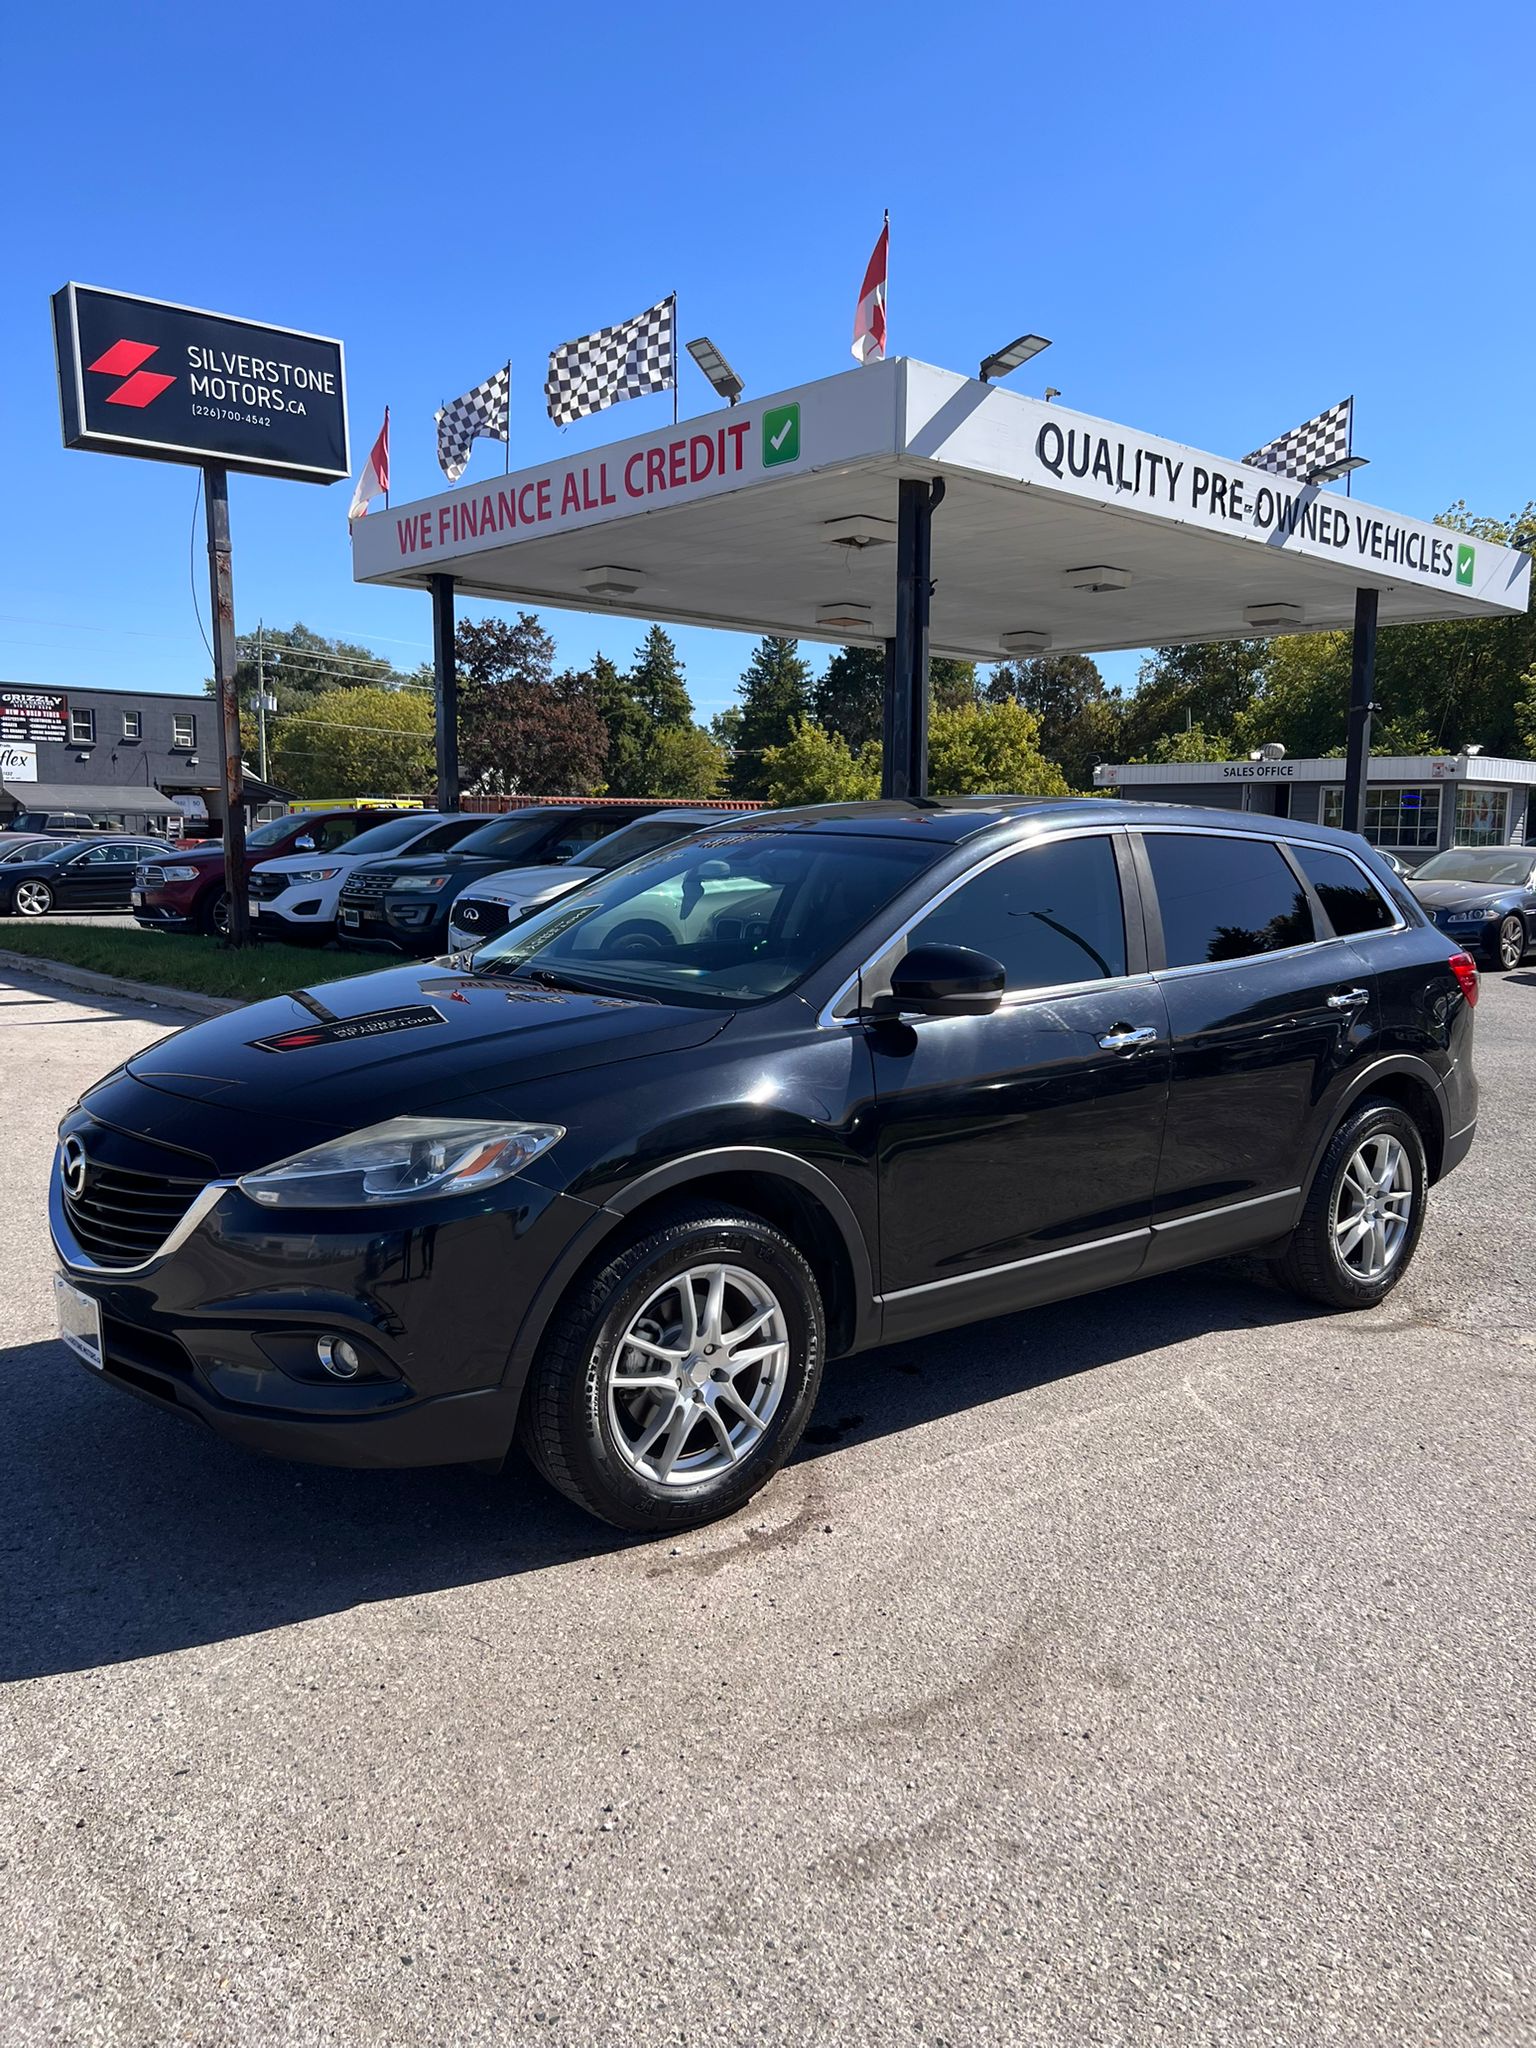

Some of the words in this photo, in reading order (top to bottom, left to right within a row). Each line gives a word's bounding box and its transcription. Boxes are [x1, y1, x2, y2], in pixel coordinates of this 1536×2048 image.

[187, 345, 335, 395] SILVERSTONE
[190, 373, 307, 416] MOTORS.CA
[192, 403, 271, 427] (226)700-4542
[397, 511, 433, 555] WE
[438, 478, 552, 546] FINANCE
[560, 462, 617, 516] ALL
[624, 420, 751, 499] CREDIT
[1038, 421, 1184, 502] QUALITY
[1191, 466, 1350, 549] PRE-OWNED
[1356, 515, 1454, 577] VEHICLES
[1, 694, 62, 705] GRIZZLY
[1223, 767, 1255, 777] SALES
[1256, 766, 1293, 777] OFFICE
